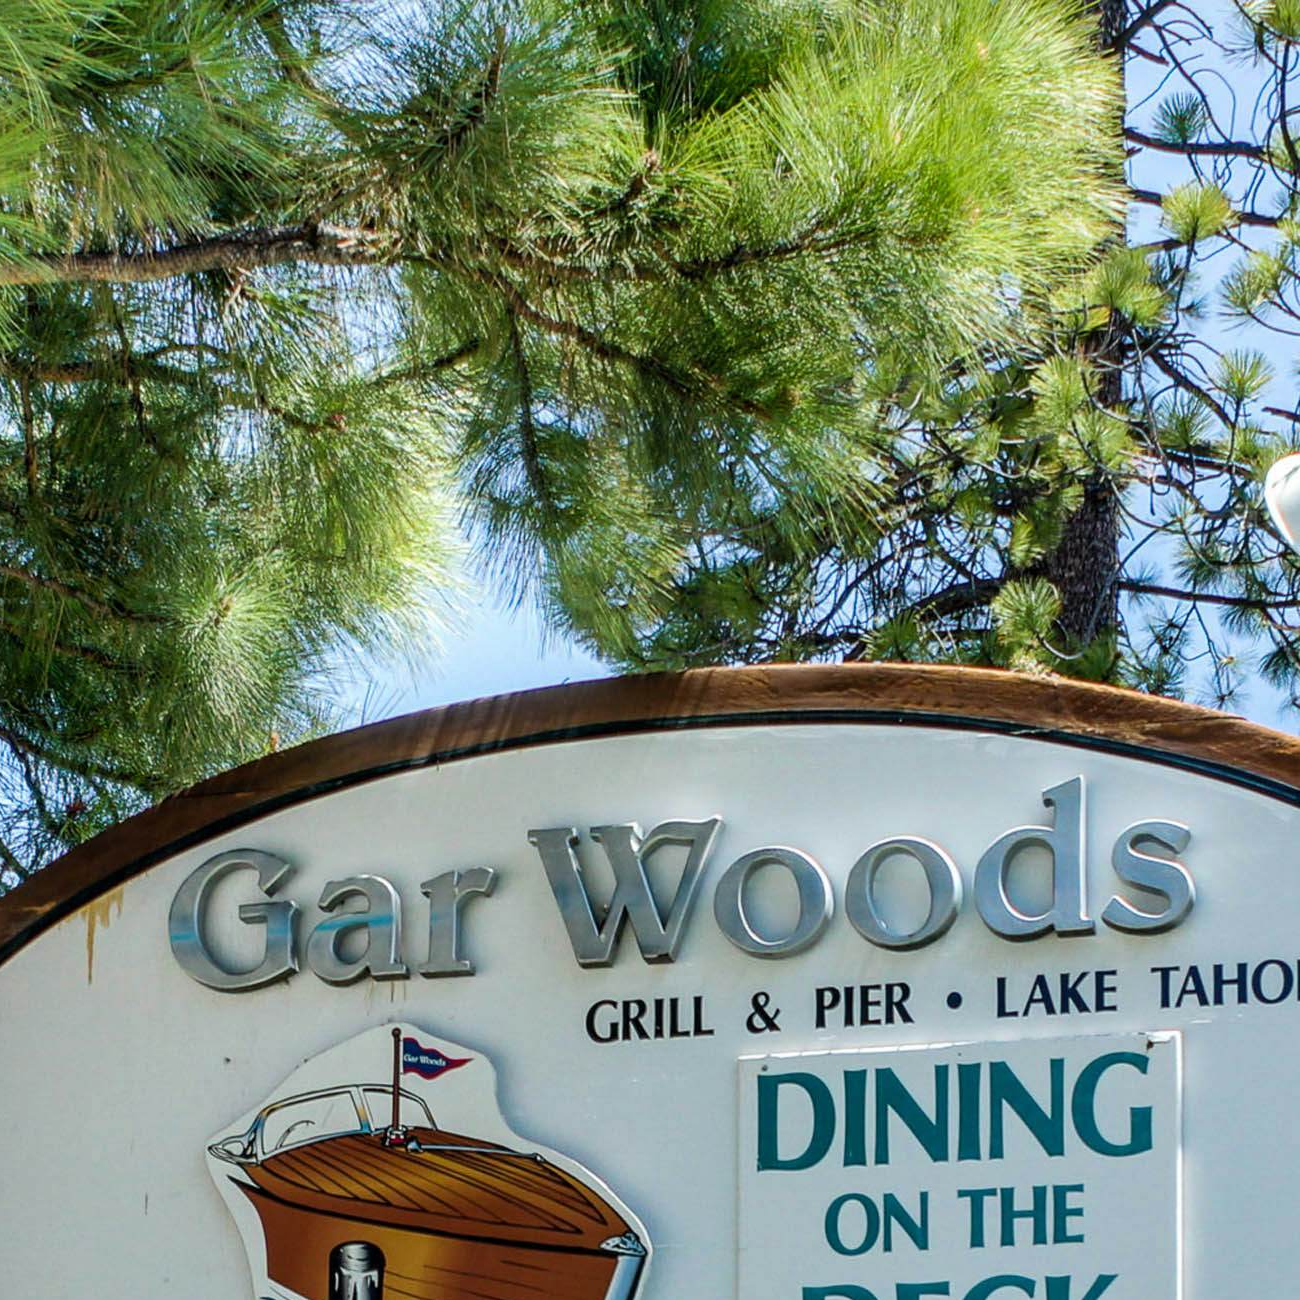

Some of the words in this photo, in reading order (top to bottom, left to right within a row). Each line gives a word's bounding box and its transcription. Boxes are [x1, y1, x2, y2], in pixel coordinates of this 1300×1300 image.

[168, 848, 500, 993] Gar
[527, 774, 1197, 968] Woods
[585, 996, 715, 1043] GRILL
[746, 991, 781, 1034] &
[815, 982, 914, 1029] PIER
[996, 969, 1118, 1018] LAKE
[757, 1051, 1153, 1172] DINING
[824, 1191, 929, 1256] ON
[957, 1184, 1085, 1248] THE
